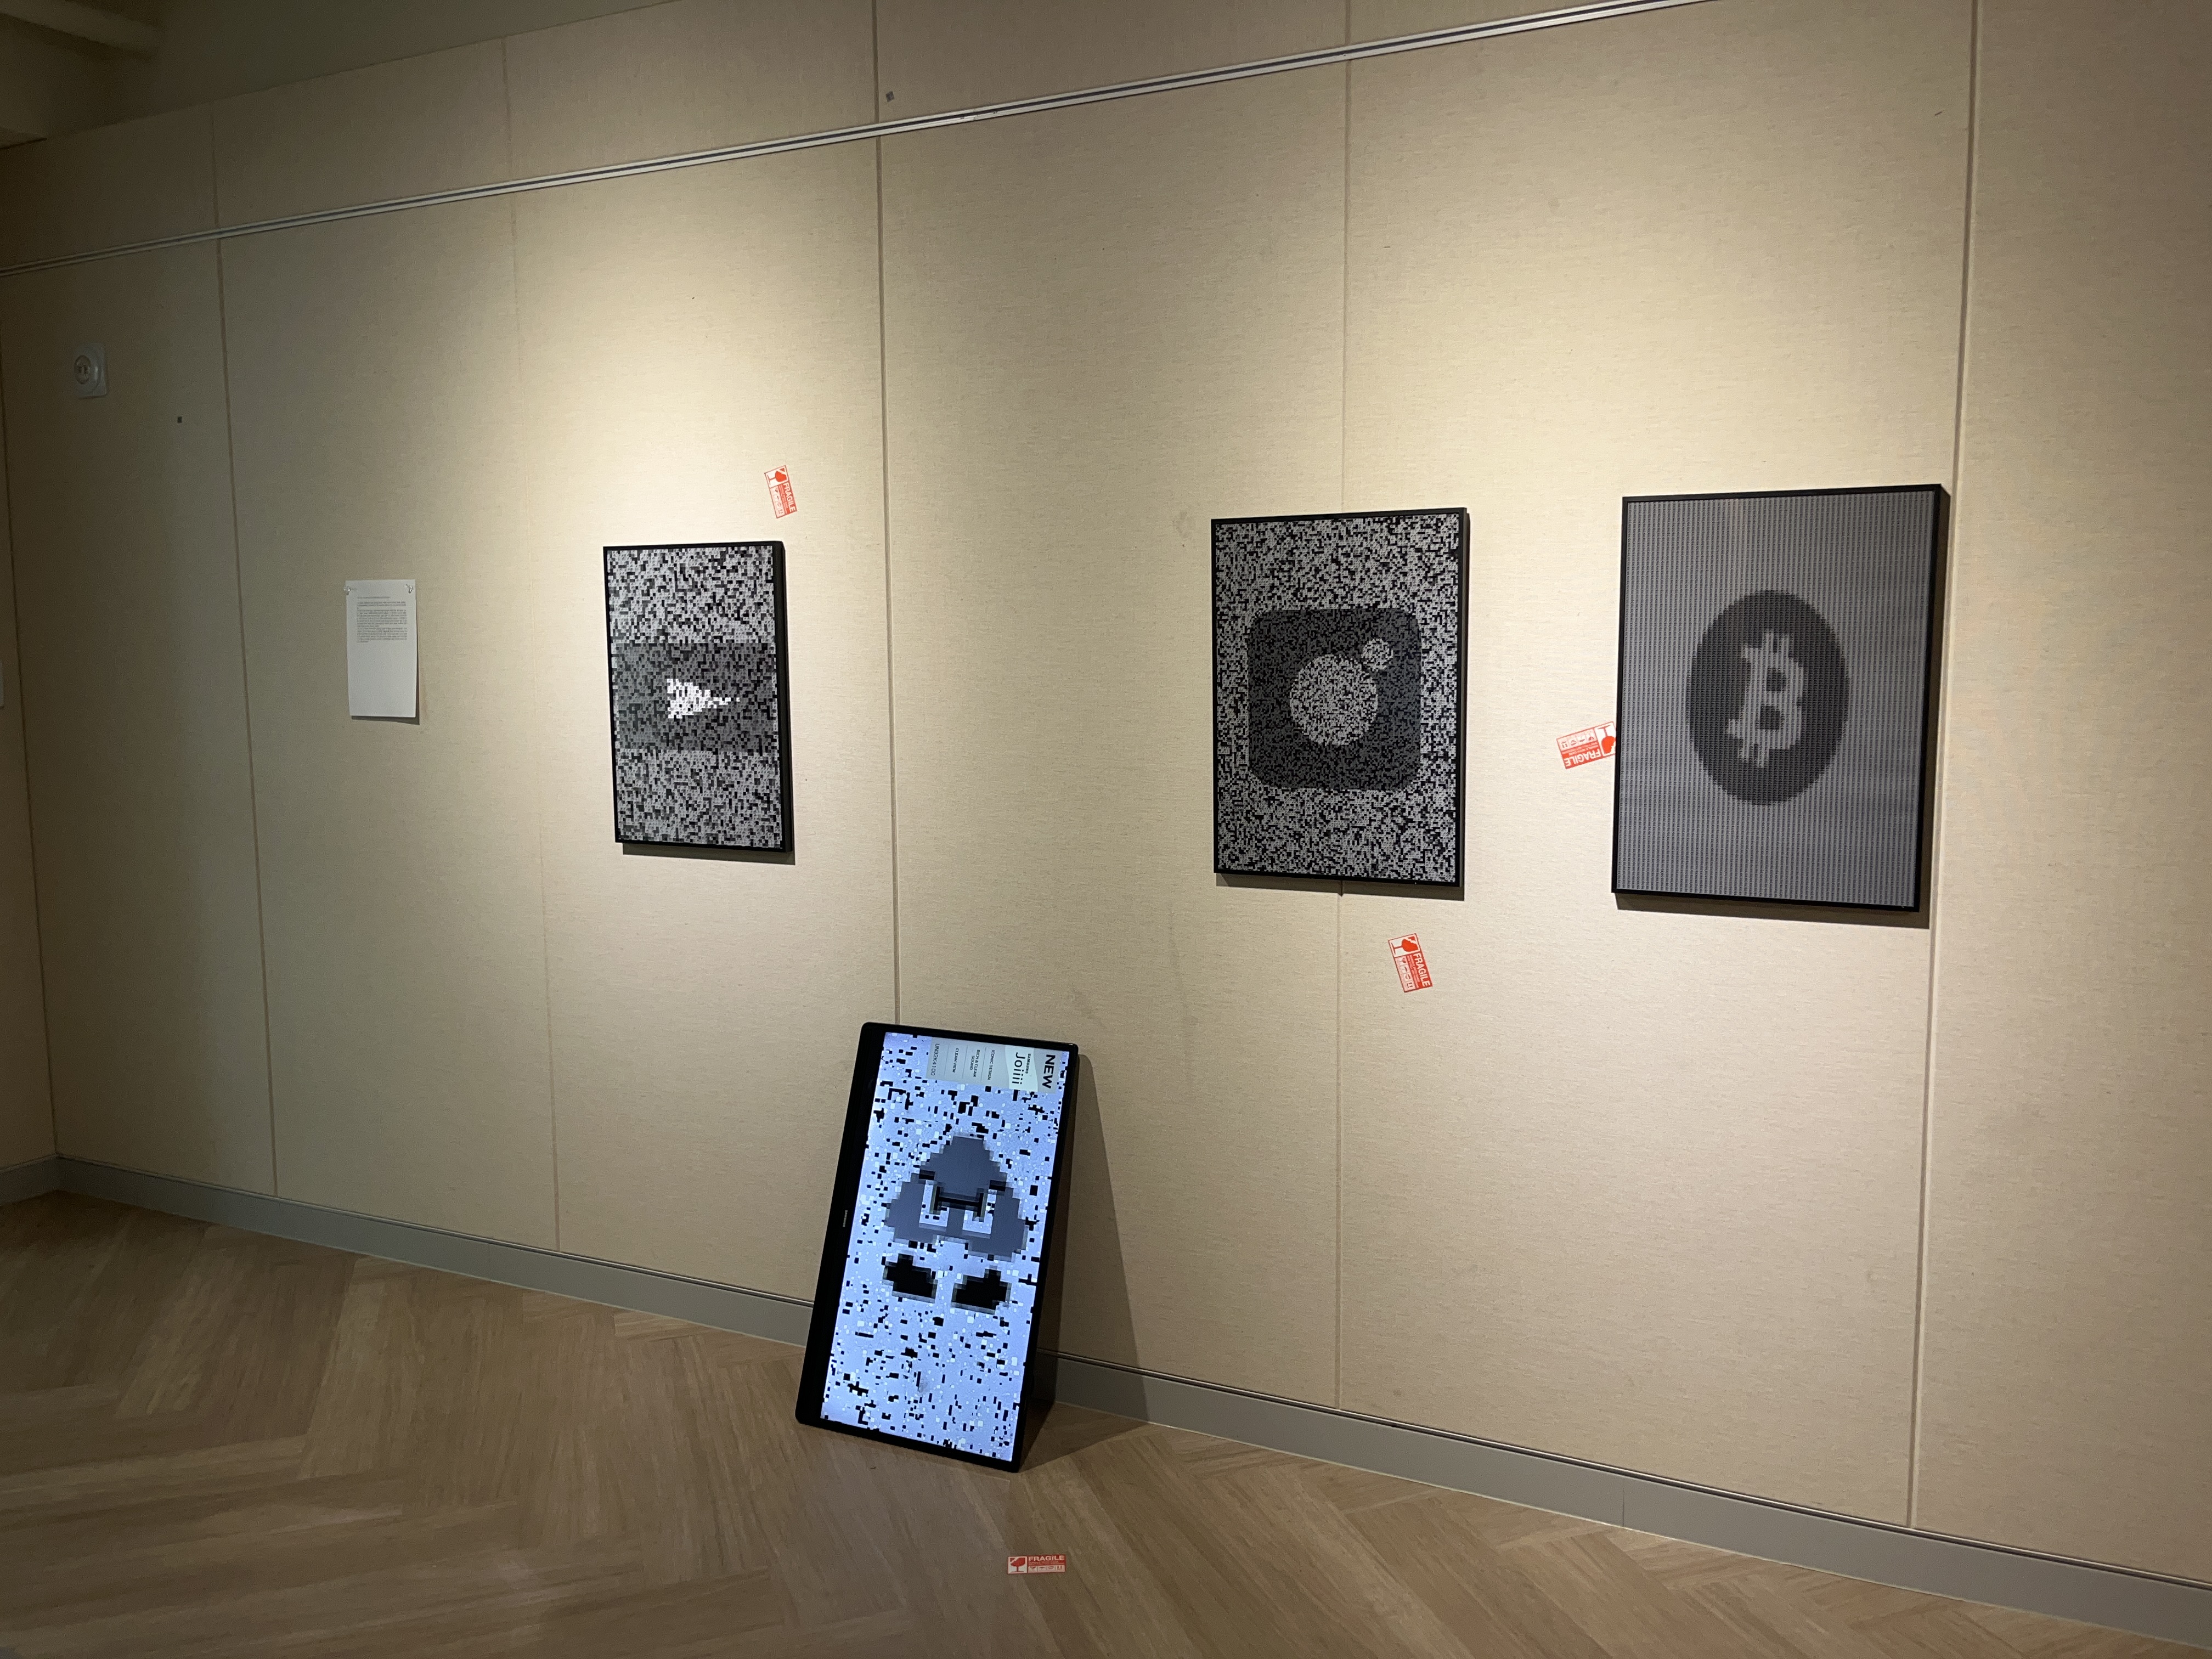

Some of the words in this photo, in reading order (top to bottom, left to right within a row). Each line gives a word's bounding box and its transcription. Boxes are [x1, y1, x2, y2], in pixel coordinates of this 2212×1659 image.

[783, 482, 795, 512] FRAGILE
[1564, 748, 1601, 767] FRAGILE
[1413, 952, 1431, 987] FRAGILE
[1012, 1052, 1026, 1085] Joiiii
[1042, 1054, 1056, 1089] NEW
